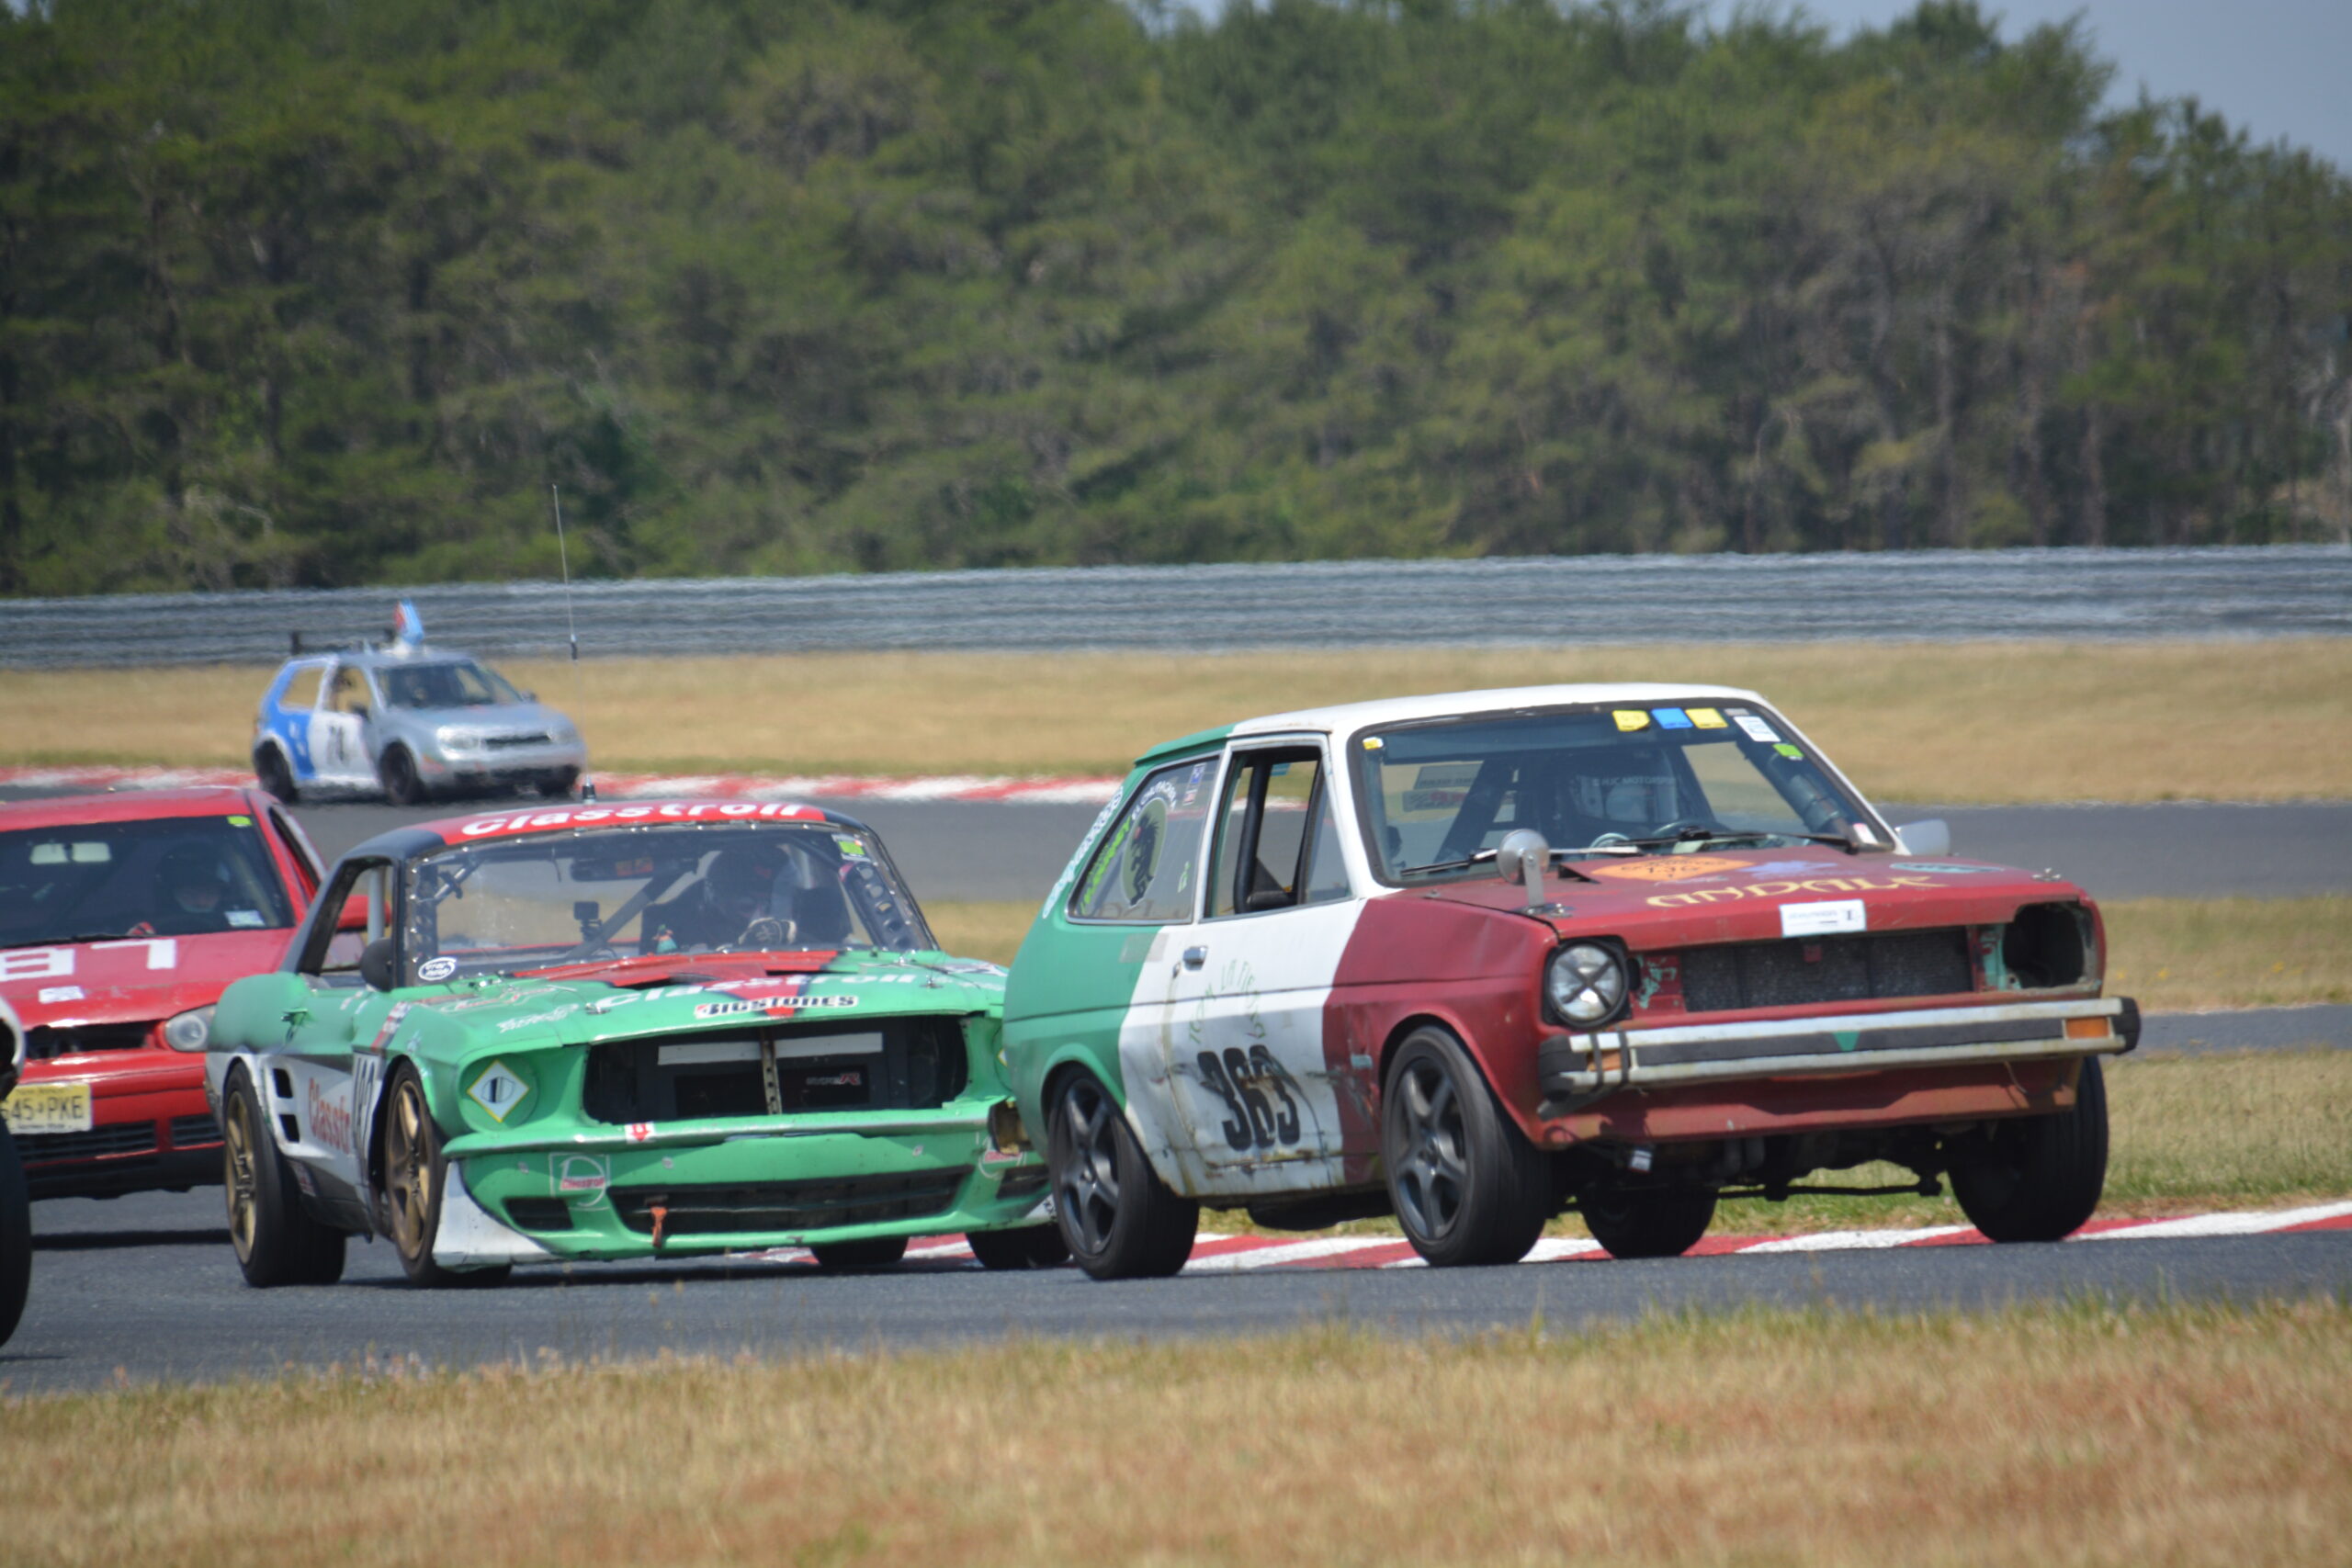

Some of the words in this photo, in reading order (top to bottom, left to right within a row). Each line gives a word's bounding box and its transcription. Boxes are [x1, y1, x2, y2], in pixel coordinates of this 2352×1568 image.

[462, 804, 804, 835] Classtroll
[1646, 875, 1950, 908] ANDALE
[596, 975, 917, 1008] Classtroll
